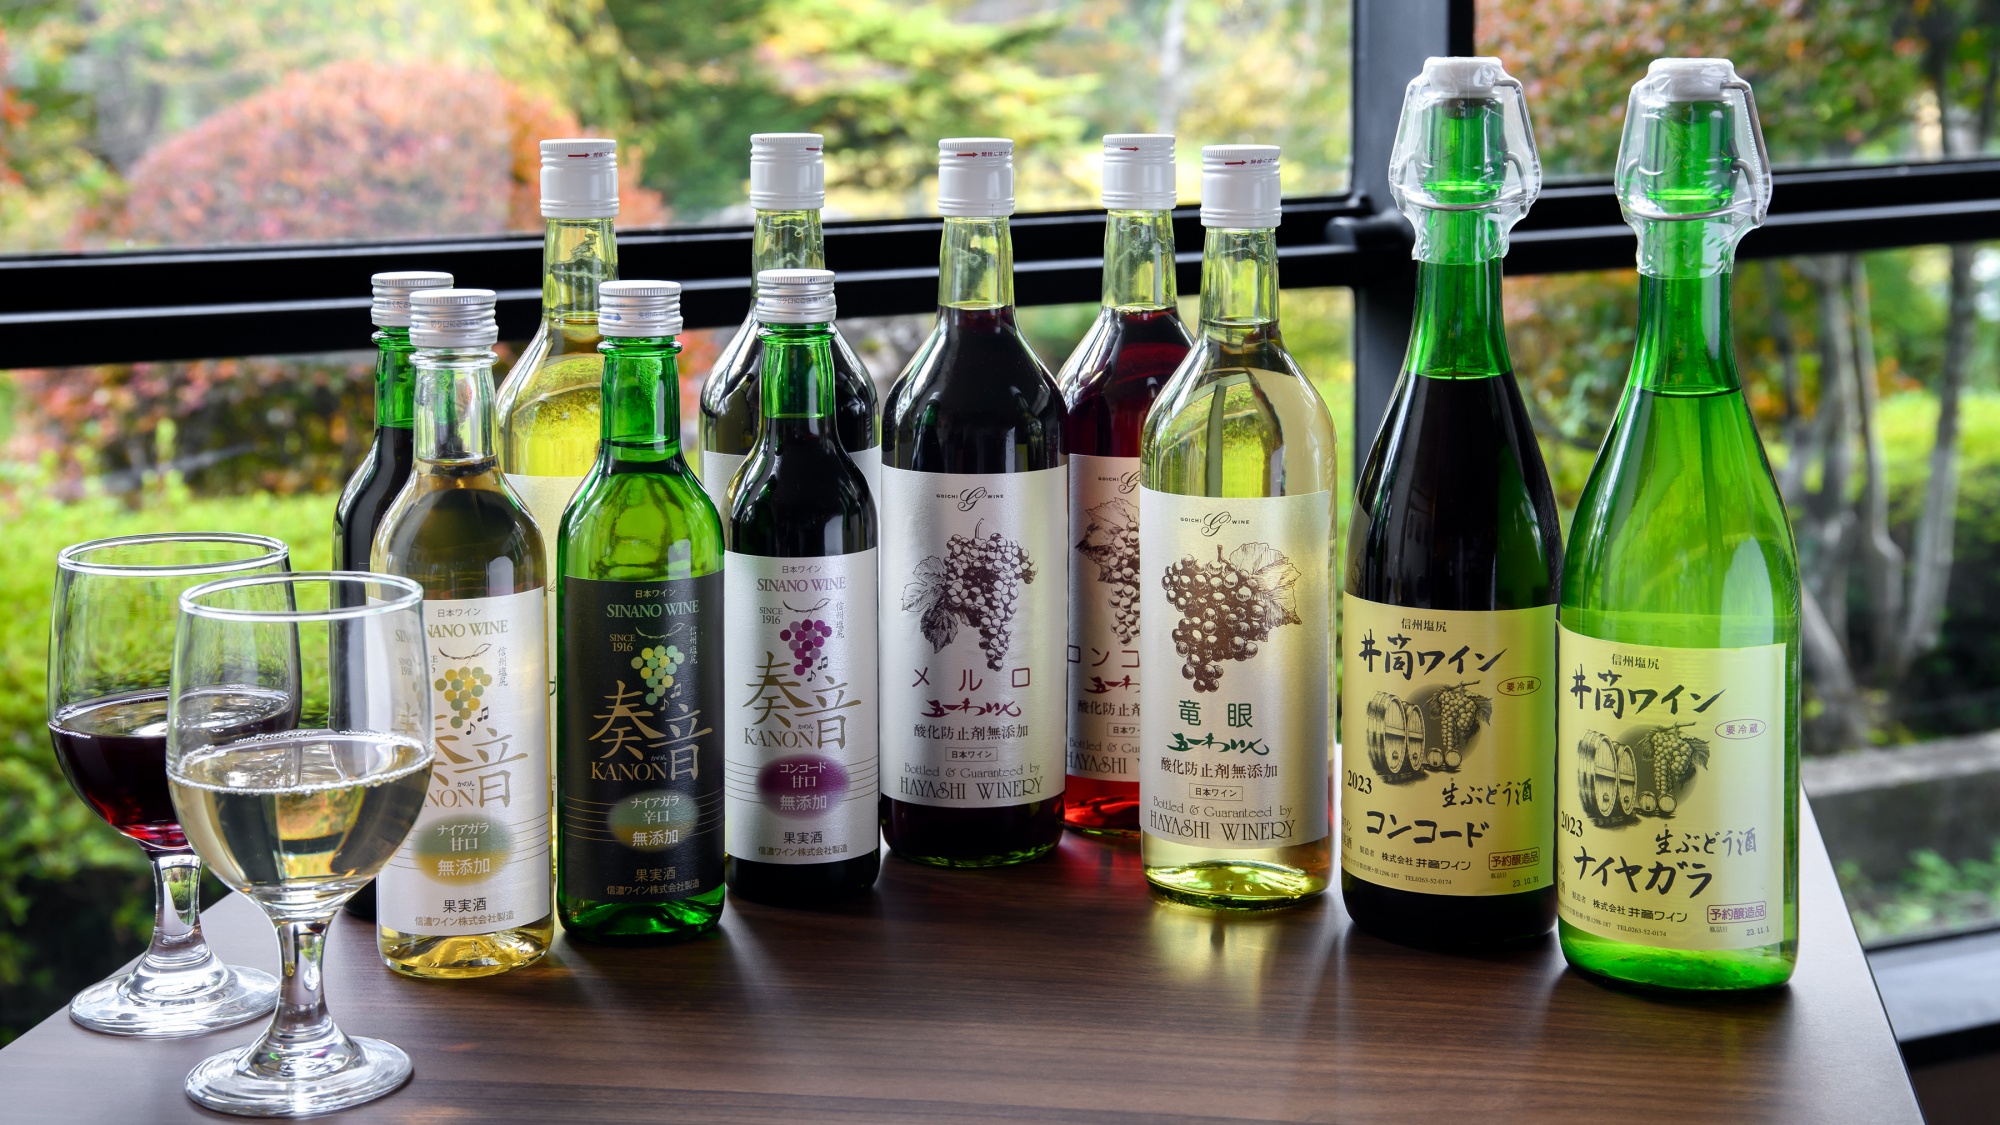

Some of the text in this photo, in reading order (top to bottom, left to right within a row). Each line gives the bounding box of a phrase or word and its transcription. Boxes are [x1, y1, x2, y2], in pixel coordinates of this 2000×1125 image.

[782, 565, 822, 574] 日本ワイン
[757, 576, 847, 592] SINANO WINE
[635, 589, 677, 599] 日本ワイン
[437, 607, 482, 618] 日本ワイン
[606, 600, 700, 618] SINANO WINE
[759, 606, 784, 616] SINCE
[761, 614, 782, 625] 1916
[1401, 617, 1447, 633] 信州塩尻
[427, 623, 466, 638] NANO
[469, 619, 509, 637] WINE
[609, 633, 636, 642] SINCE
[612, 642, 634, 652] 1916
[1358, 628, 1508, 681] 井筒ワイン
[1611, 653, 1660, 670] 信州塩尻
[911, 666, 1031, 692] メルロ
[1506, 679, 1536, 693] 要冷蔵
[1570, 663, 1727, 720] 井筒ワイン
[742, 651, 863, 750] 奏音
[1178, 699, 1253, 728] 竜眼
[588, 680, 713, 782] 奏音
[744, 727, 814, 749] KANON
[913, 723, 1029, 741] 酸化防止剤無添加
[1112, 725, 1141, 735] 日本ワ
[1725, 723, 1759, 736] 要冷蔵
[1069, 737, 1102, 752] Bottled
[1107, 742, 1117, 753] &
[951, 750, 993, 759] 日本ワイン
[590, 761, 668, 782] KANON
[779, 761, 828, 774] コンコード
[904, 762, 1041, 779] Bottled & Guaranteed by
[1160, 756, 1278, 779] 酸化防止剤無添加
[790, 775, 817, 789] 甘口
[900, 775, 1044, 801] HAYASHI WINERY
[1347, 769, 1373, 795] 2023
[424, 788, 475, 809] NON
[1194, 787, 1238, 798] 日本ワイン
[1441, 777, 1533, 808] 生ぶどう酒
[630, 795, 680, 809] ナイアガラ
[780, 794, 828, 811] 無添加
[1153, 795, 1293, 819] Bottled & Guaranteed by
[642, 810, 670, 825] 辛口
[1150, 809, 1296, 842] HAYASHI WINERY
[1560, 810, 1584, 838] 2023
[437, 822, 490, 836] ナイアガラ
[783, 830, 824, 845] 果実酒
[1366, 810, 1490, 849] コンコード
[449, 837, 479, 852] 甘口
[632, 829, 679, 847] 無添加
[1655, 827, 1757, 858] 生ぶどう酒
[758, 844, 849, 858] 信濃ワイン株式会社製造
[1381, 851, 1414, 867] 株式会社
[1491, 851, 1539, 868] 予約醸造品
[437, 857, 491, 877] 無添加
[634, 866, 677, 883] 果実酒
[1573, 845, 1713, 899] ナイヤガラ
[606, 878, 701, 896] 信濃ワイン株式会社製造
[442, 897, 487, 914] 果実酒
[1592, 898, 1627, 916] 株式会社
[1709, 904, 1765, 921] 予約醸造品
[414, 910, 515, 927] 信濃ワイン株式会社製造
[1616, 924, 1667, 937] TEL0263-52-0174
